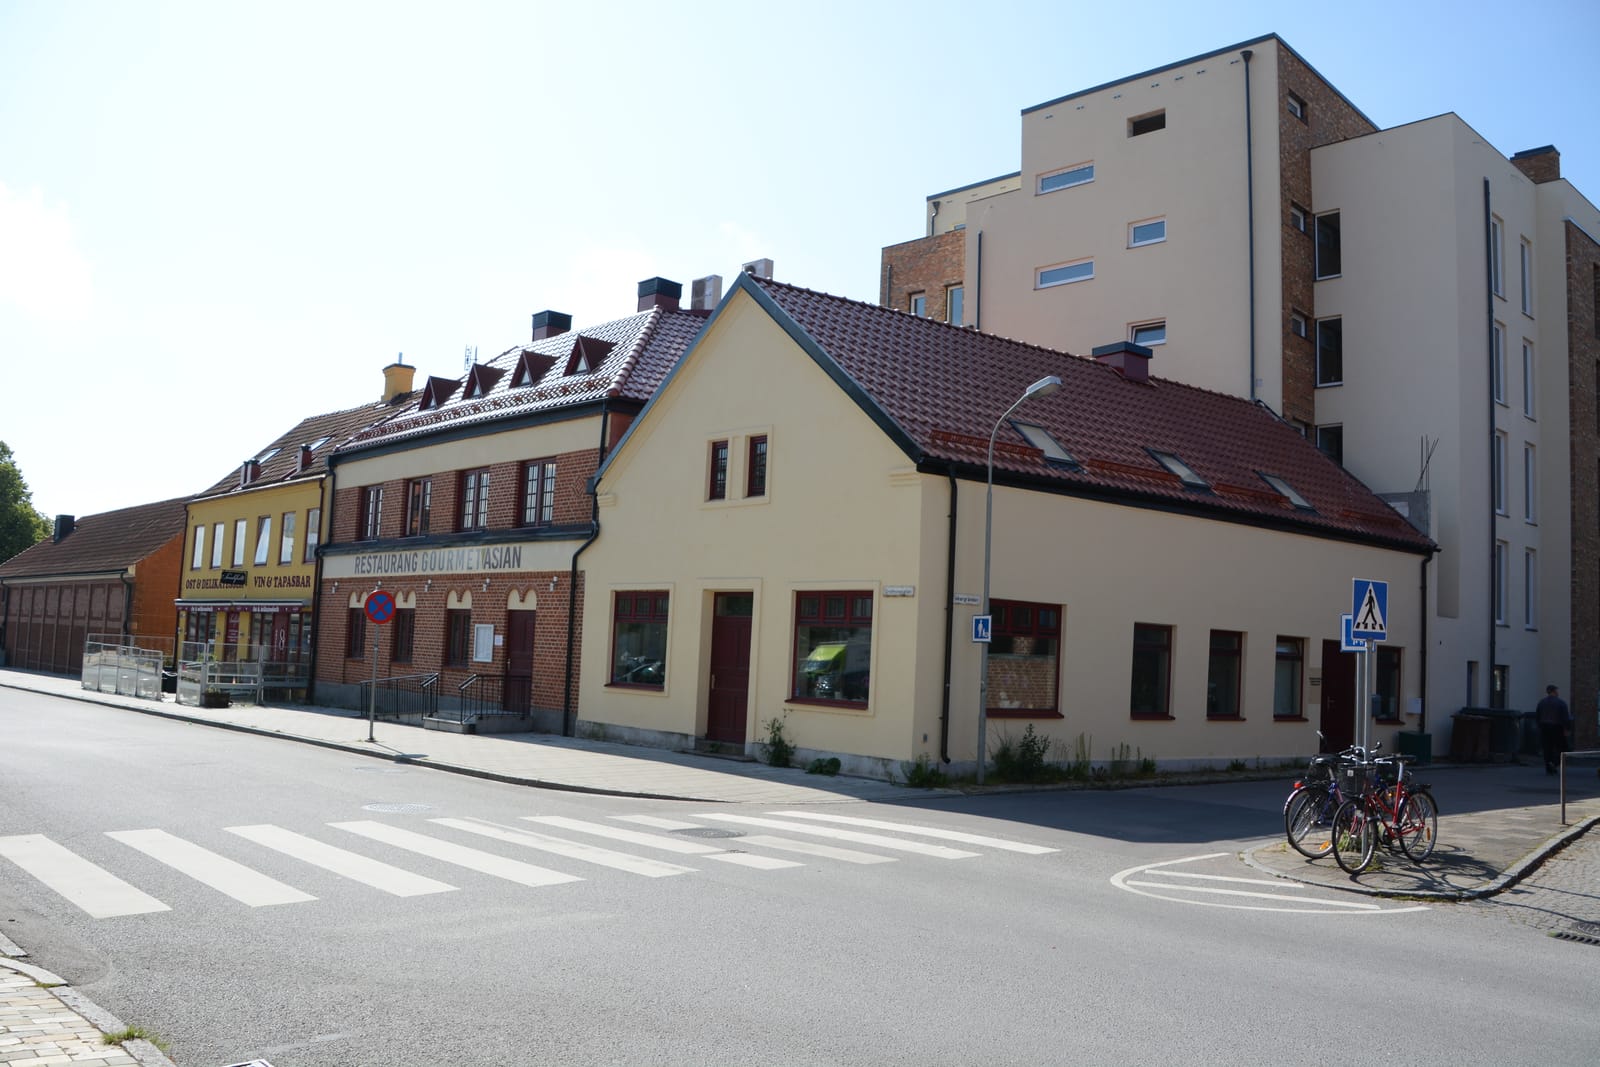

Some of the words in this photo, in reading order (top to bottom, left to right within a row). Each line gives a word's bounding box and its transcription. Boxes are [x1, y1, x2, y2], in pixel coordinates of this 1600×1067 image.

[354, 551, 418, 574] RESTAURANG
[421, 549, 482, 572] GOURMET
[483, 546, 522, 569] ASIAN
[186, 579, 196, 589] OST
[254, 576, 266, 588] VIN
[266, 576, 273, 588] &
[273, 575, 311, 588] TAPASBAR
